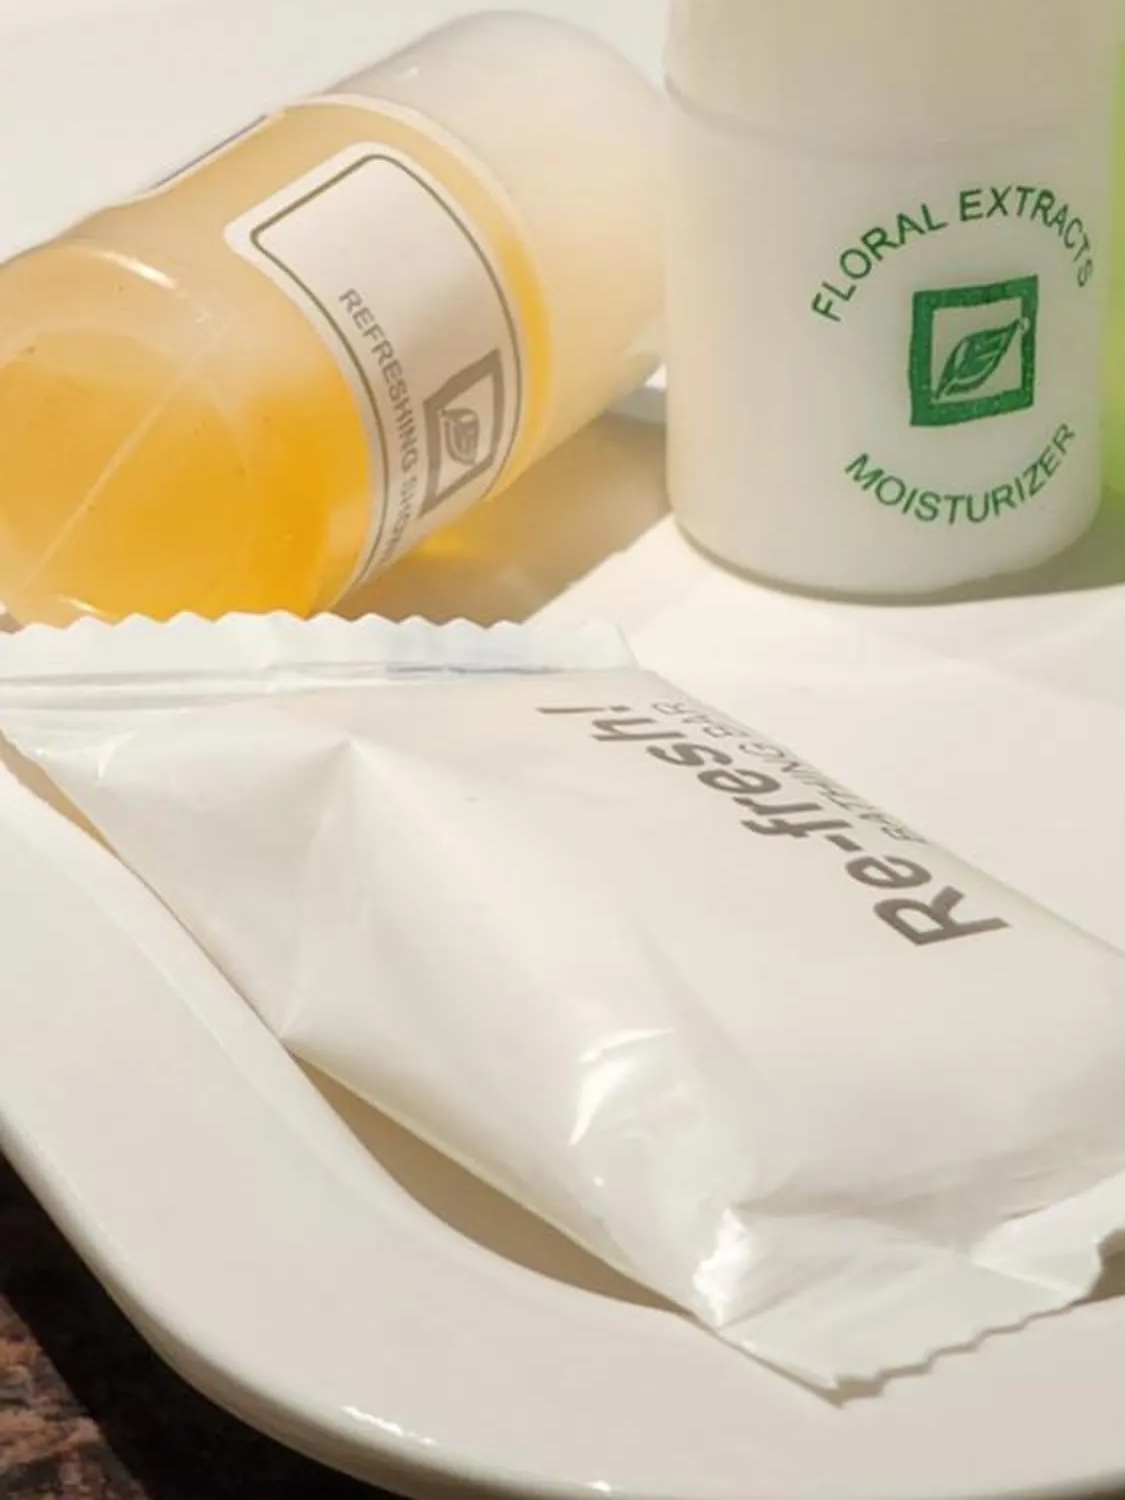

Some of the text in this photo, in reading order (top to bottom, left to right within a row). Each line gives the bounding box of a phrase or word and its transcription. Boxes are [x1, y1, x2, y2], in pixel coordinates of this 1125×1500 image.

[812, 185, 1094, 322] FLORAL EXTRACTS
[338, 288, 418, 473] REFRESHING
[844, 423, 1075, 525] MOISTURIZER
[536, 704, 1012, 947] Re-fresh!
